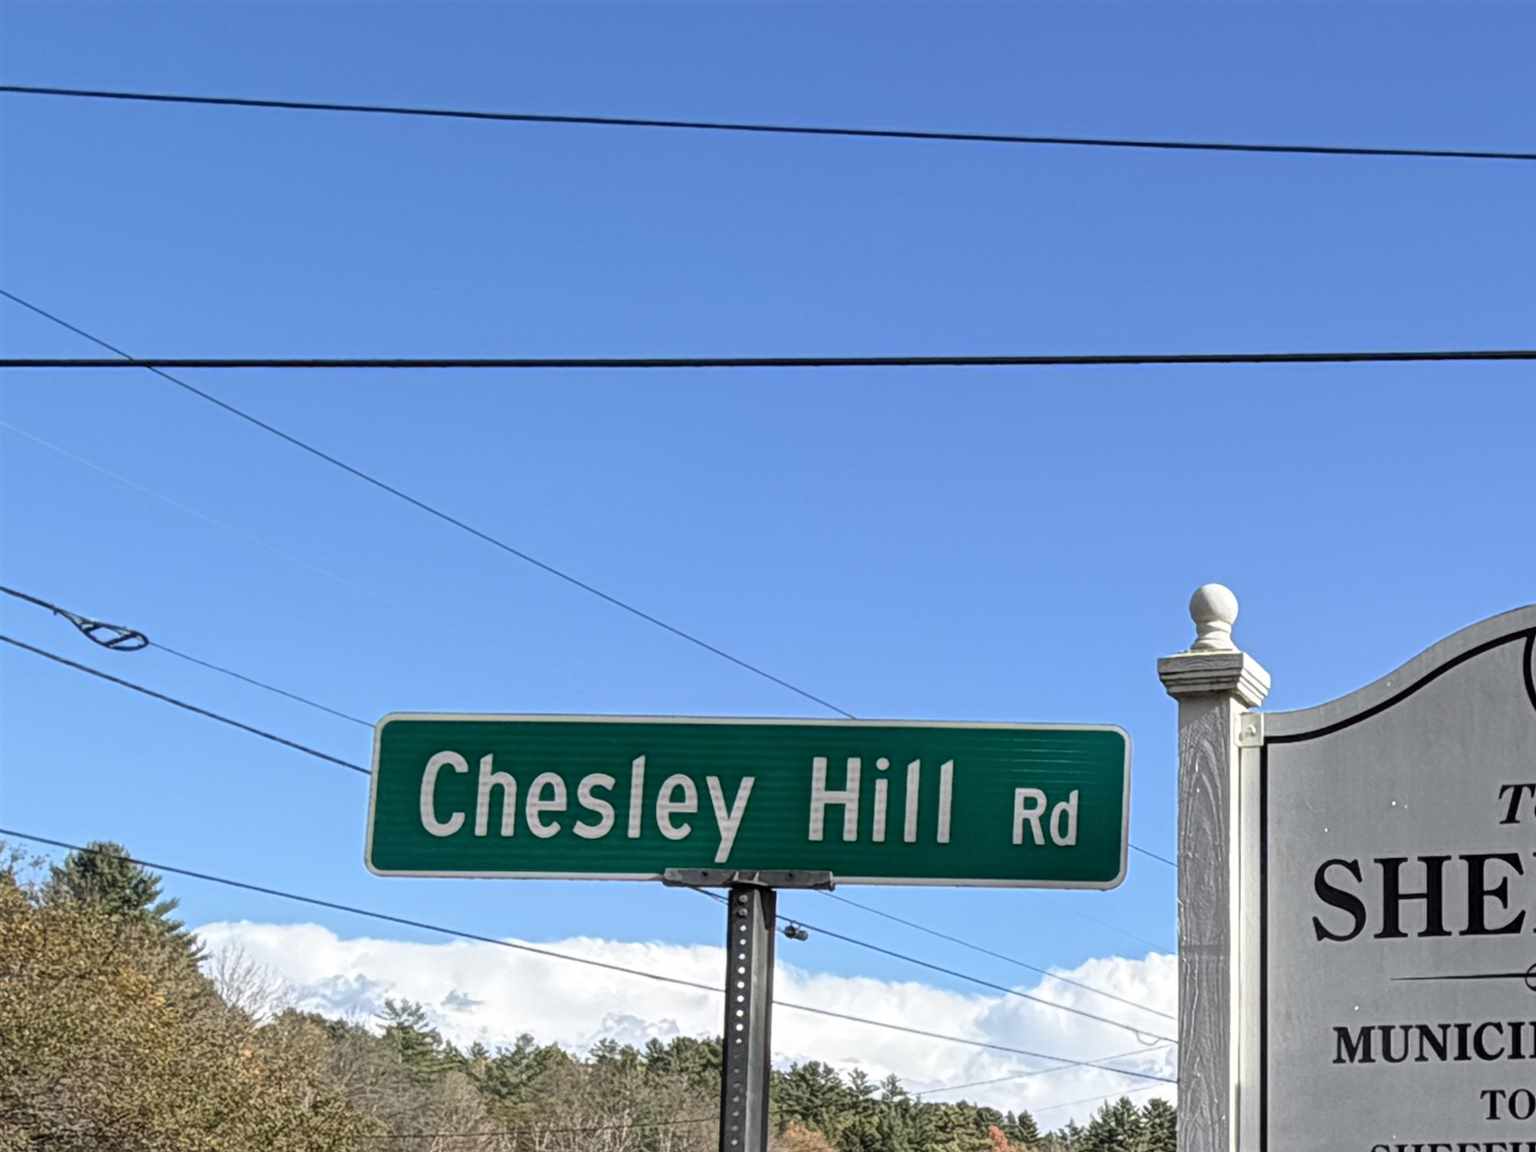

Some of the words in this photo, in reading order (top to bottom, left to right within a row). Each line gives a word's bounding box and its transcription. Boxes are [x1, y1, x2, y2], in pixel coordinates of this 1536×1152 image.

[420, 751, 755, 863] Chesley
[809, 757, 953, 843] Hill
[1013, 788, 1078, 845] Rd
